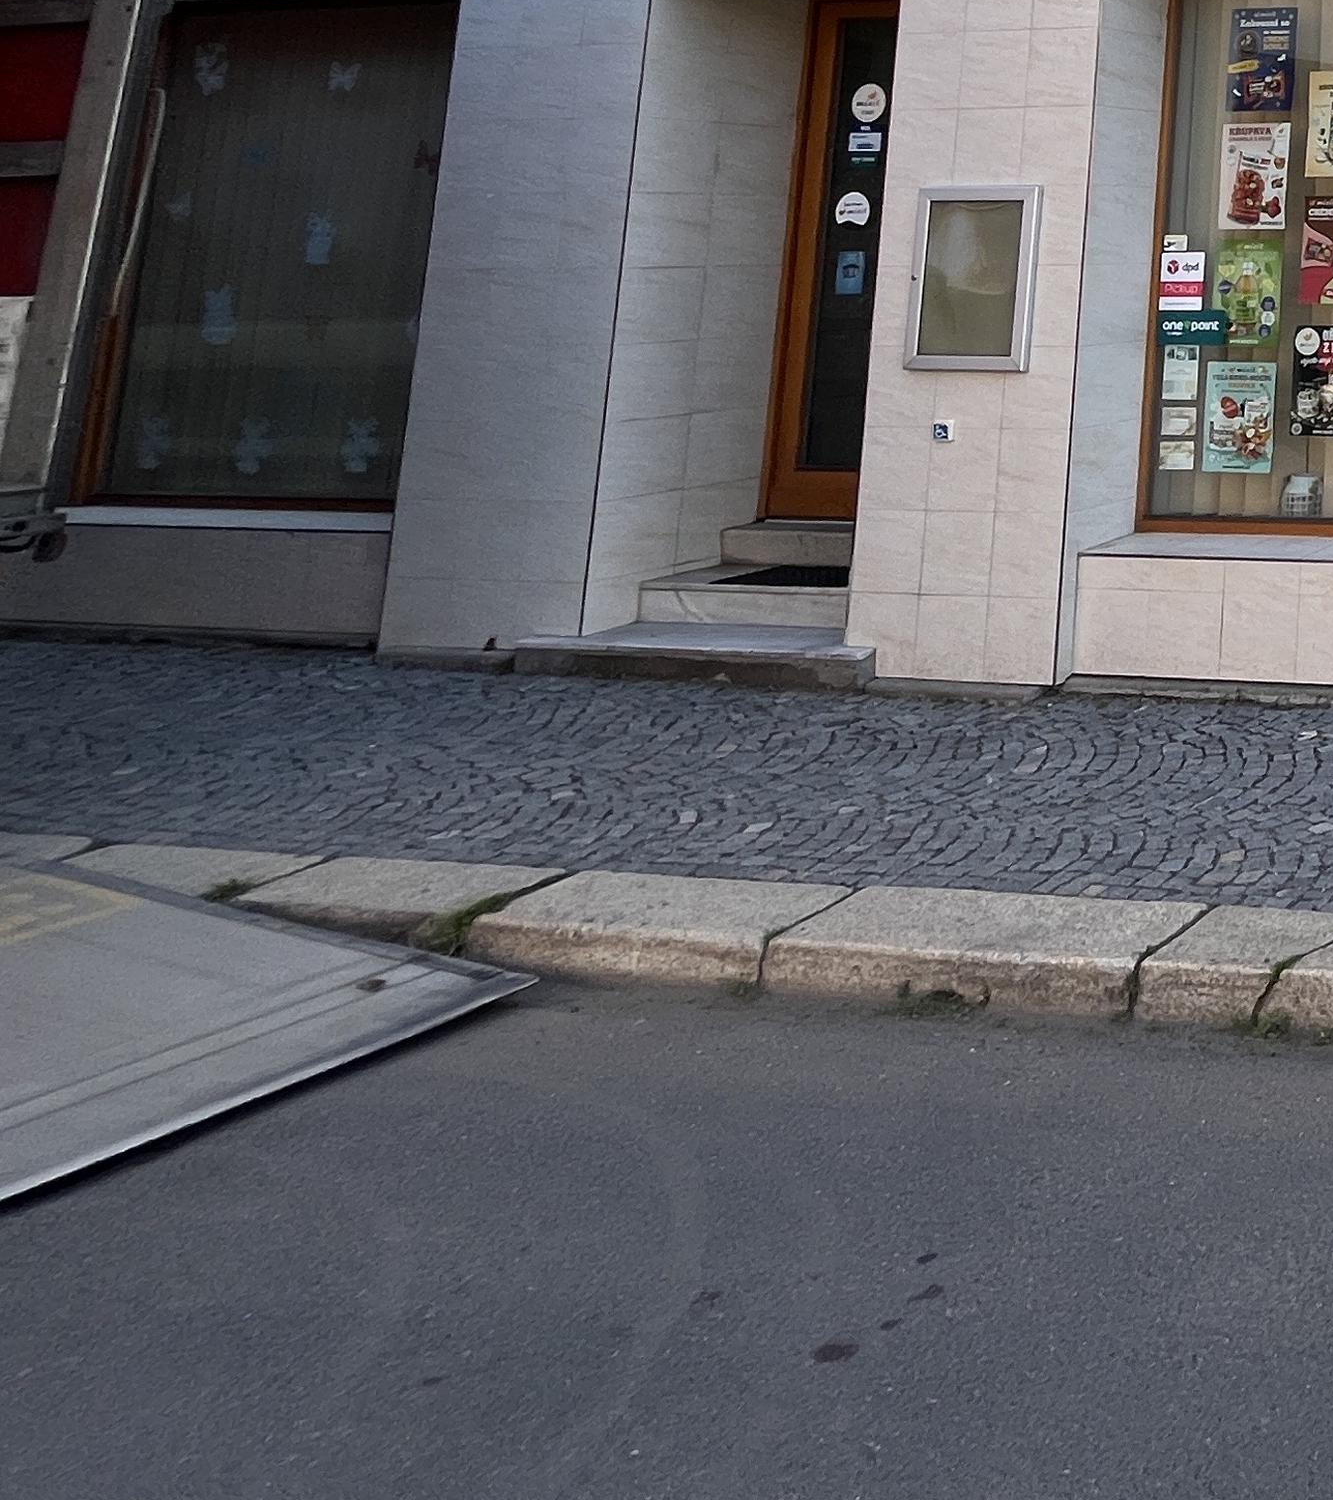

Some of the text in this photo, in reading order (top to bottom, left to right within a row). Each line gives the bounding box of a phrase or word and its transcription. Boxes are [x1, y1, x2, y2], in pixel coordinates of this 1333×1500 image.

[1182, 262, 1200, 274] dpd
[1164, 283, 1198, 294] Pickup
[1162, 320, 1220, 332] one point
